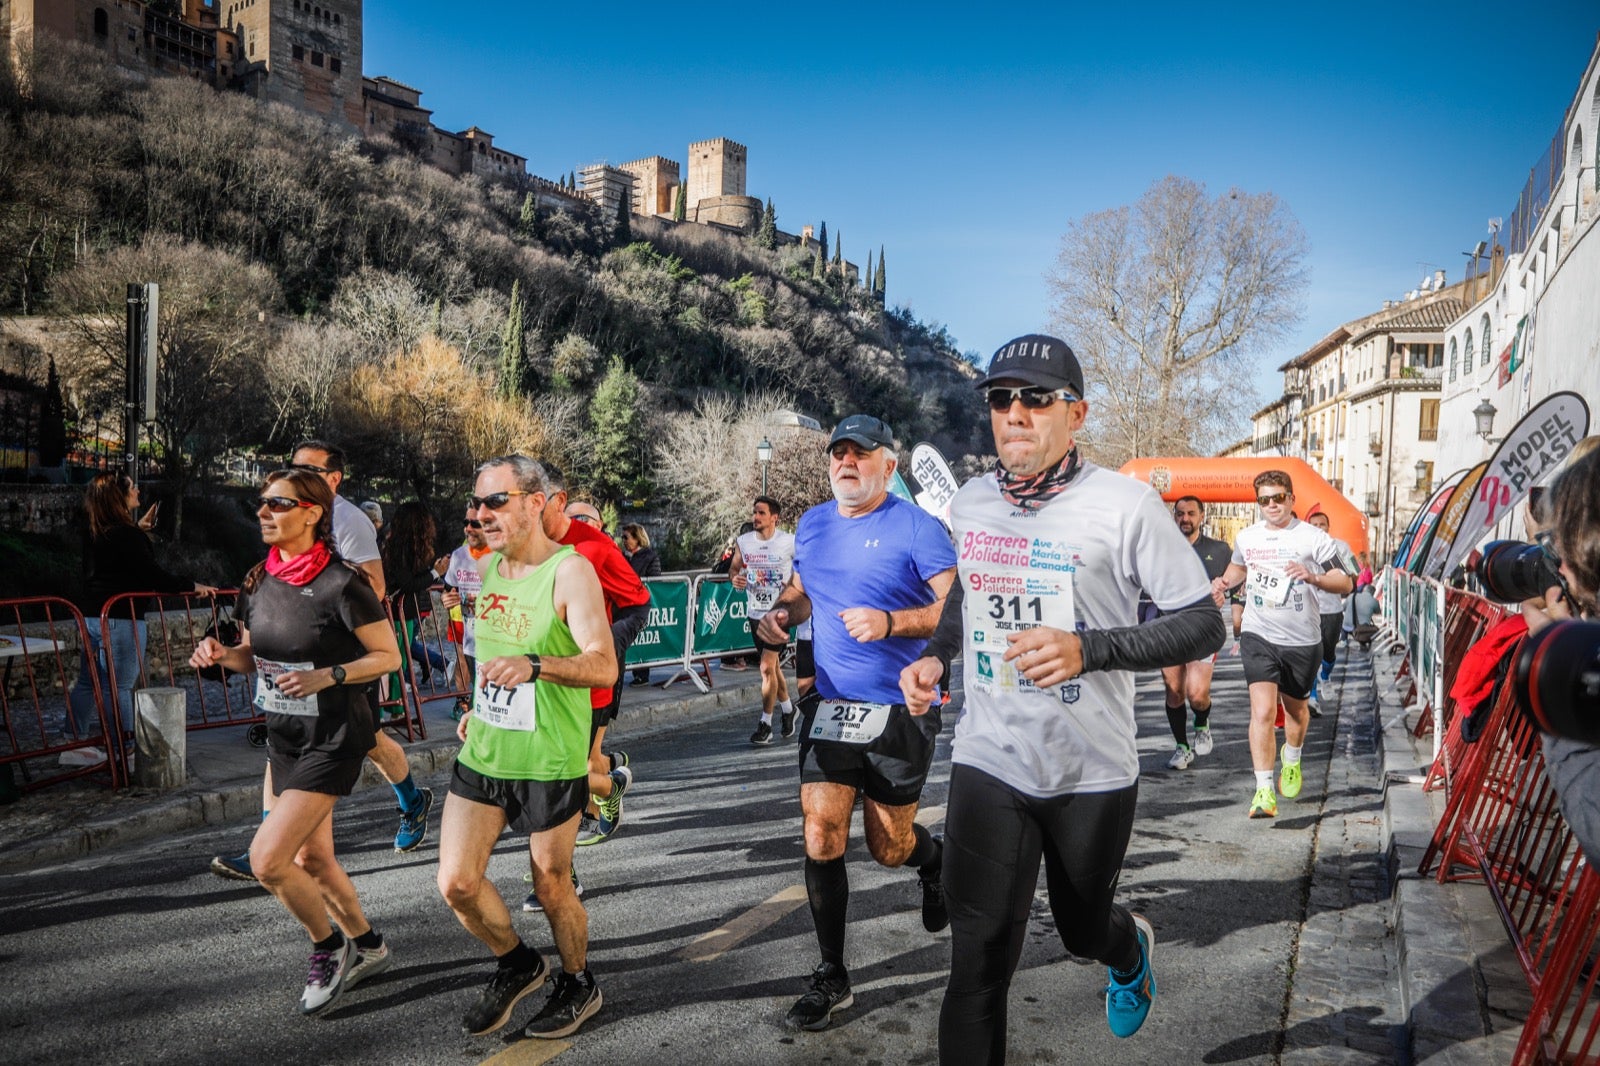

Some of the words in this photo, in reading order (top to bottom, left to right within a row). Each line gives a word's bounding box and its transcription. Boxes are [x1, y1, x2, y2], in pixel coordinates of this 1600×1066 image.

[1501, 413, 1571, 476] MODEL
[1510, 427, 1578, 493] PLAST
[976, 531, 1028, 549] Carrera
[1033, 538, 1052, 548] Ave
[970, 546, 1029, 567] Solidaria
[1030, 558, 1076, 573] Granada
[969, 573, 982, 591] 9
[982, 573, 1023, 585] Carrera
[983, 583, 1026, 595] Solidaria
[1255, 572, 1279, 588] 315
[755, 593, 773, 601] 521
[988, 595, 1042, 621] 311
[995, 621, 1013, 630] JOSE
[830, 705, 872, 723] 287
